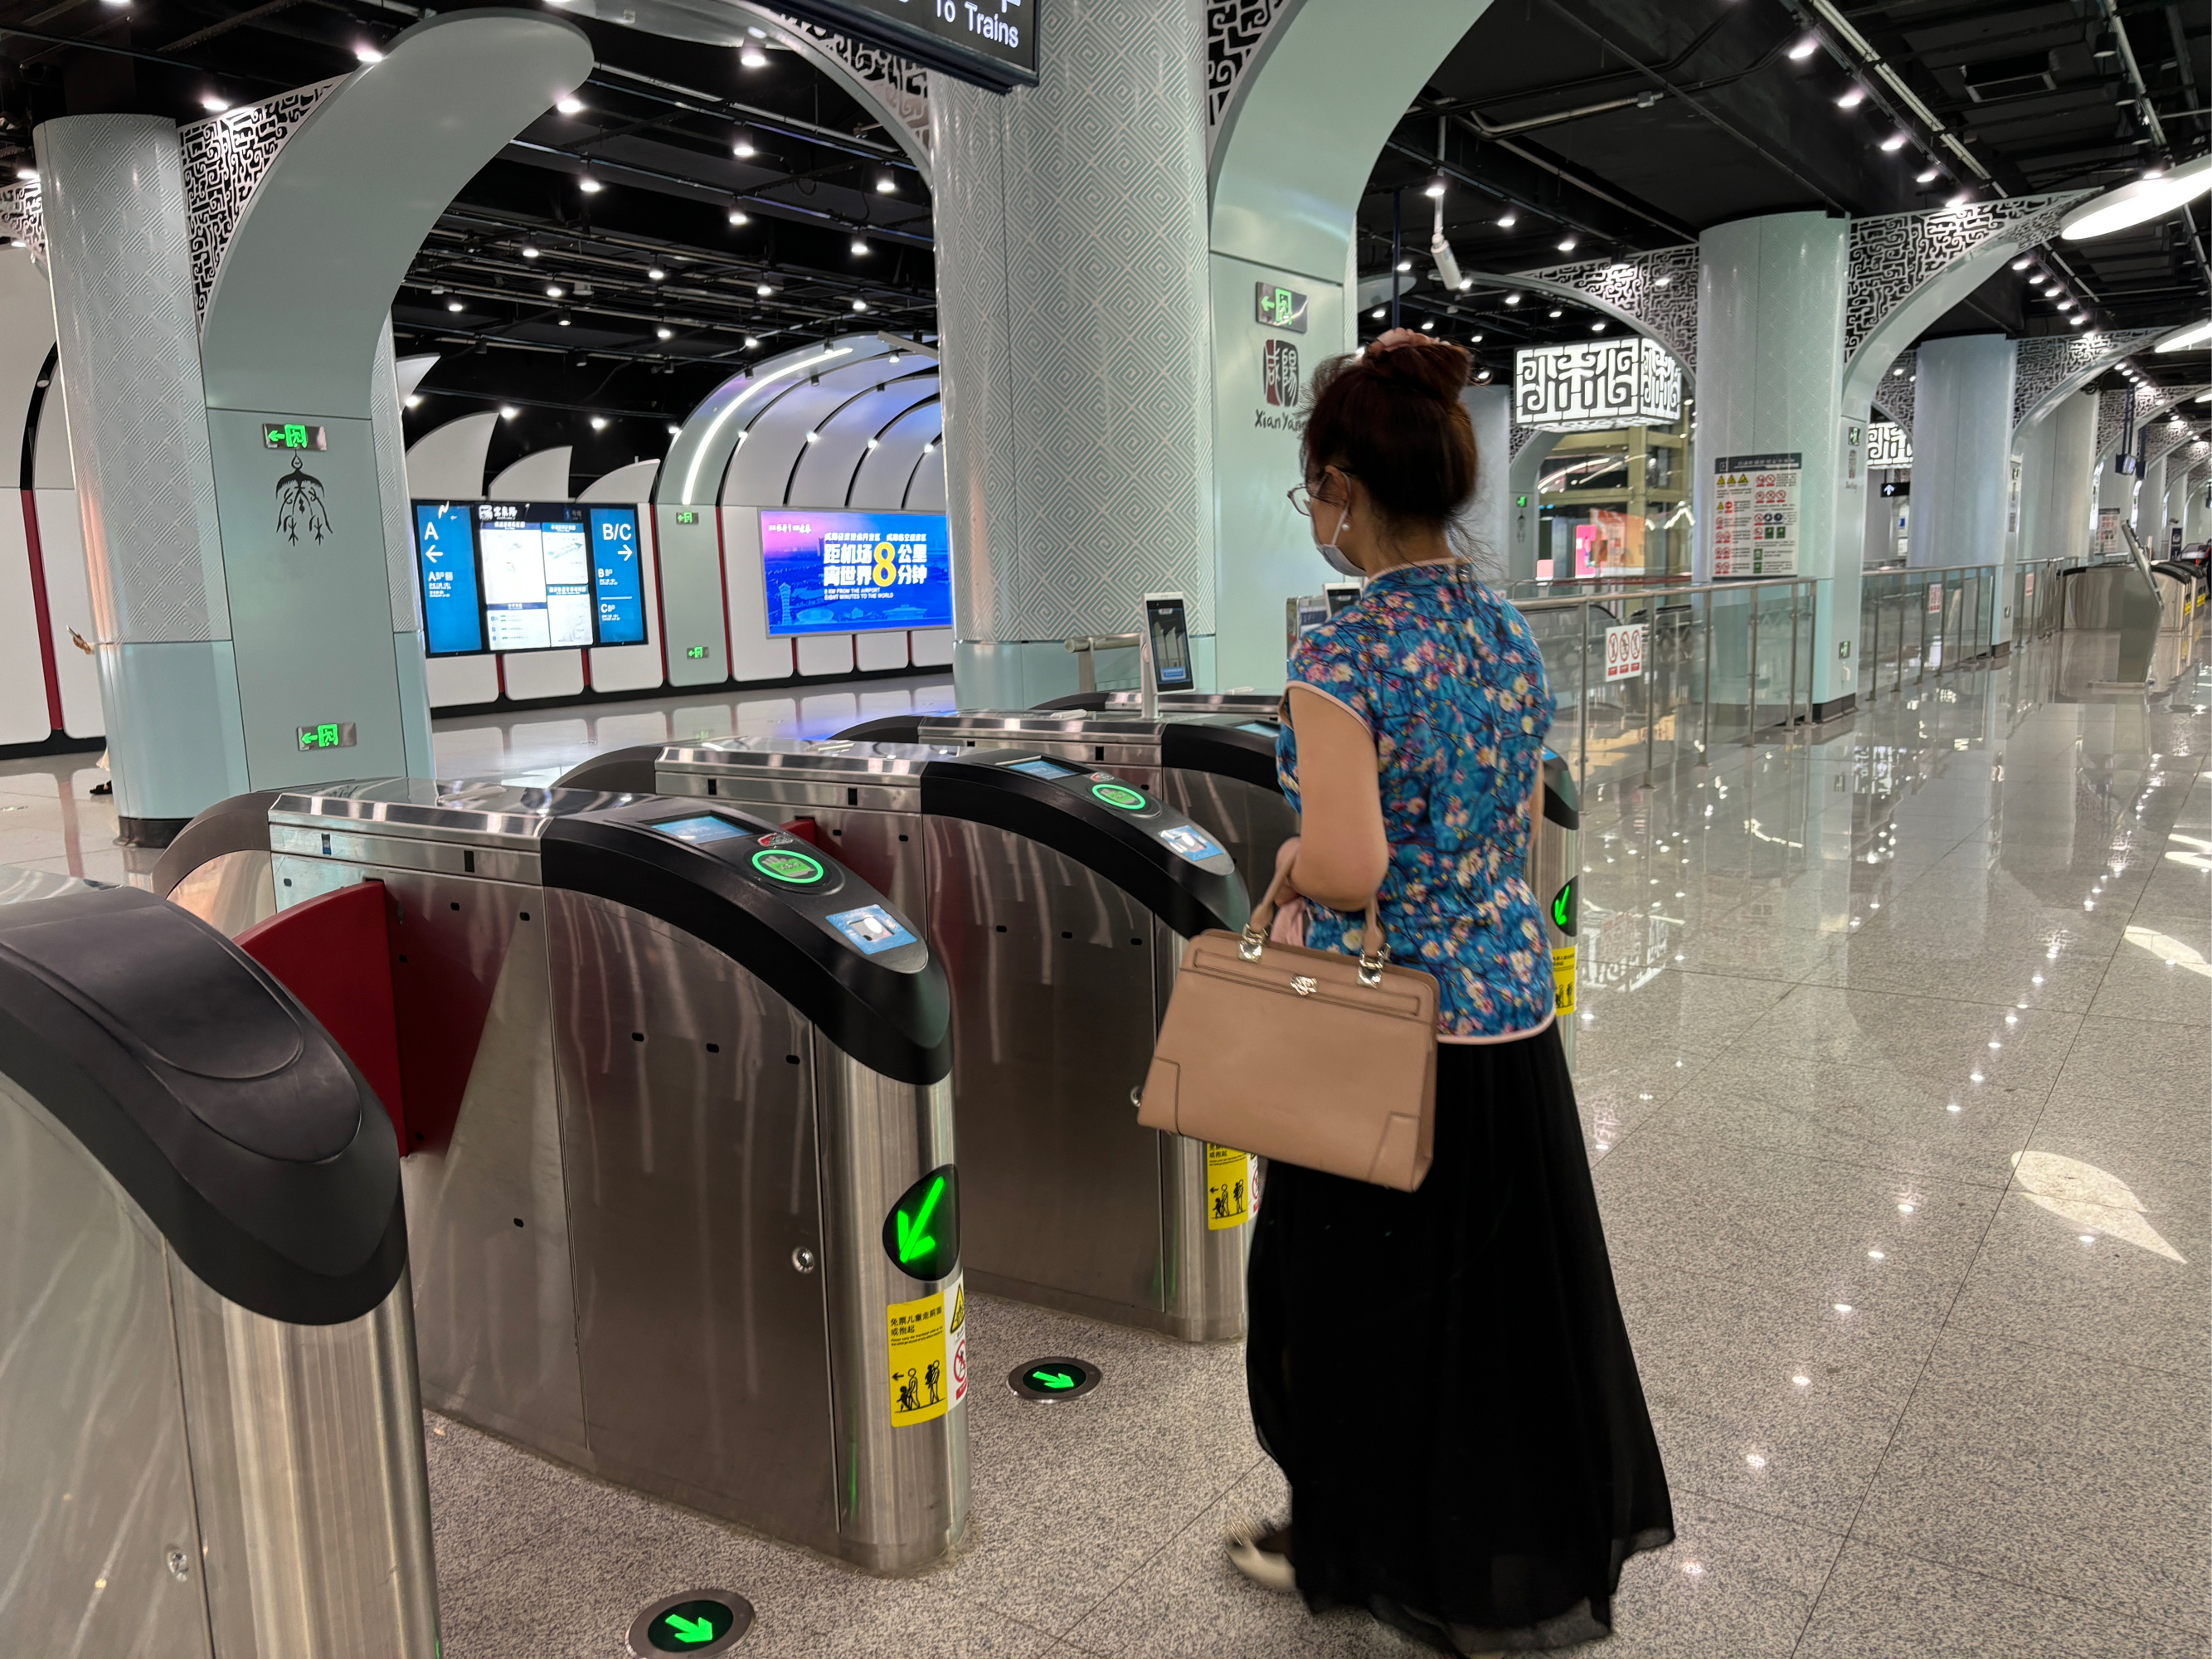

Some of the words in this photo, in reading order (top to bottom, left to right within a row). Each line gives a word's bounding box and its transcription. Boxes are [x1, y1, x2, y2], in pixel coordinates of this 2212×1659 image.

[936, 0, 955, 22] To
[964, 1, 1019, 48] Trains
[1255, 409, 1309, 432] XianYan
[424, 522, 439, 540] A
[602, 523, 632, 541] B/C
[823, 543, 873, 564] 距机场
[873, 542, 897, 586] 8
[897, 543, 927, 563] 公里
[823, 565, 872, 586] 离世界
[897, 564, 927, 585] 分钟
[891, 1306, 942, 1327] 免票儿童走前面
[891, 1325, 915, 1336] 或抱起
